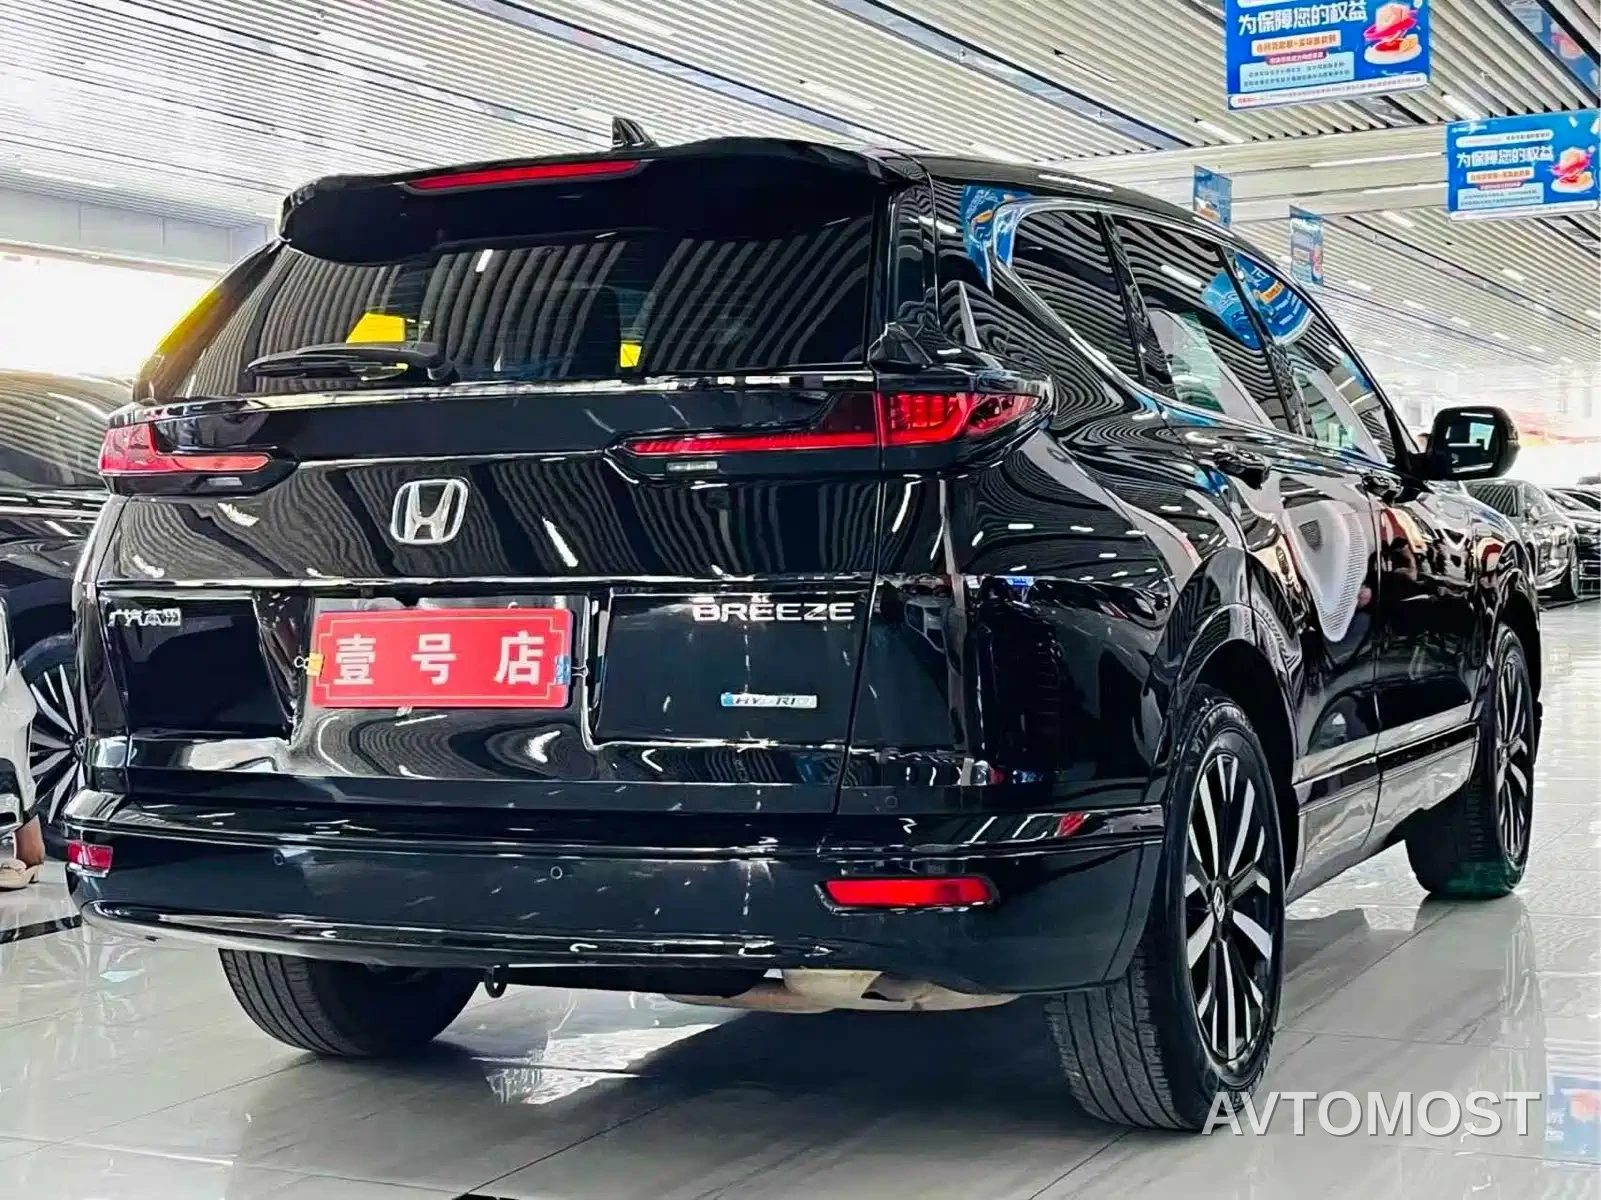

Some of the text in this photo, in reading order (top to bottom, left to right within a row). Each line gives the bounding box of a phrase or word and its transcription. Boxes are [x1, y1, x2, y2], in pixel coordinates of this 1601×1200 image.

[1238, 1, 1368, 36] 为保障您的权益
[692, 602, 855, 623] BREEZE
[334, 630, 545, 686] 壹号店
[735, 696, 814, 707] HYRI
